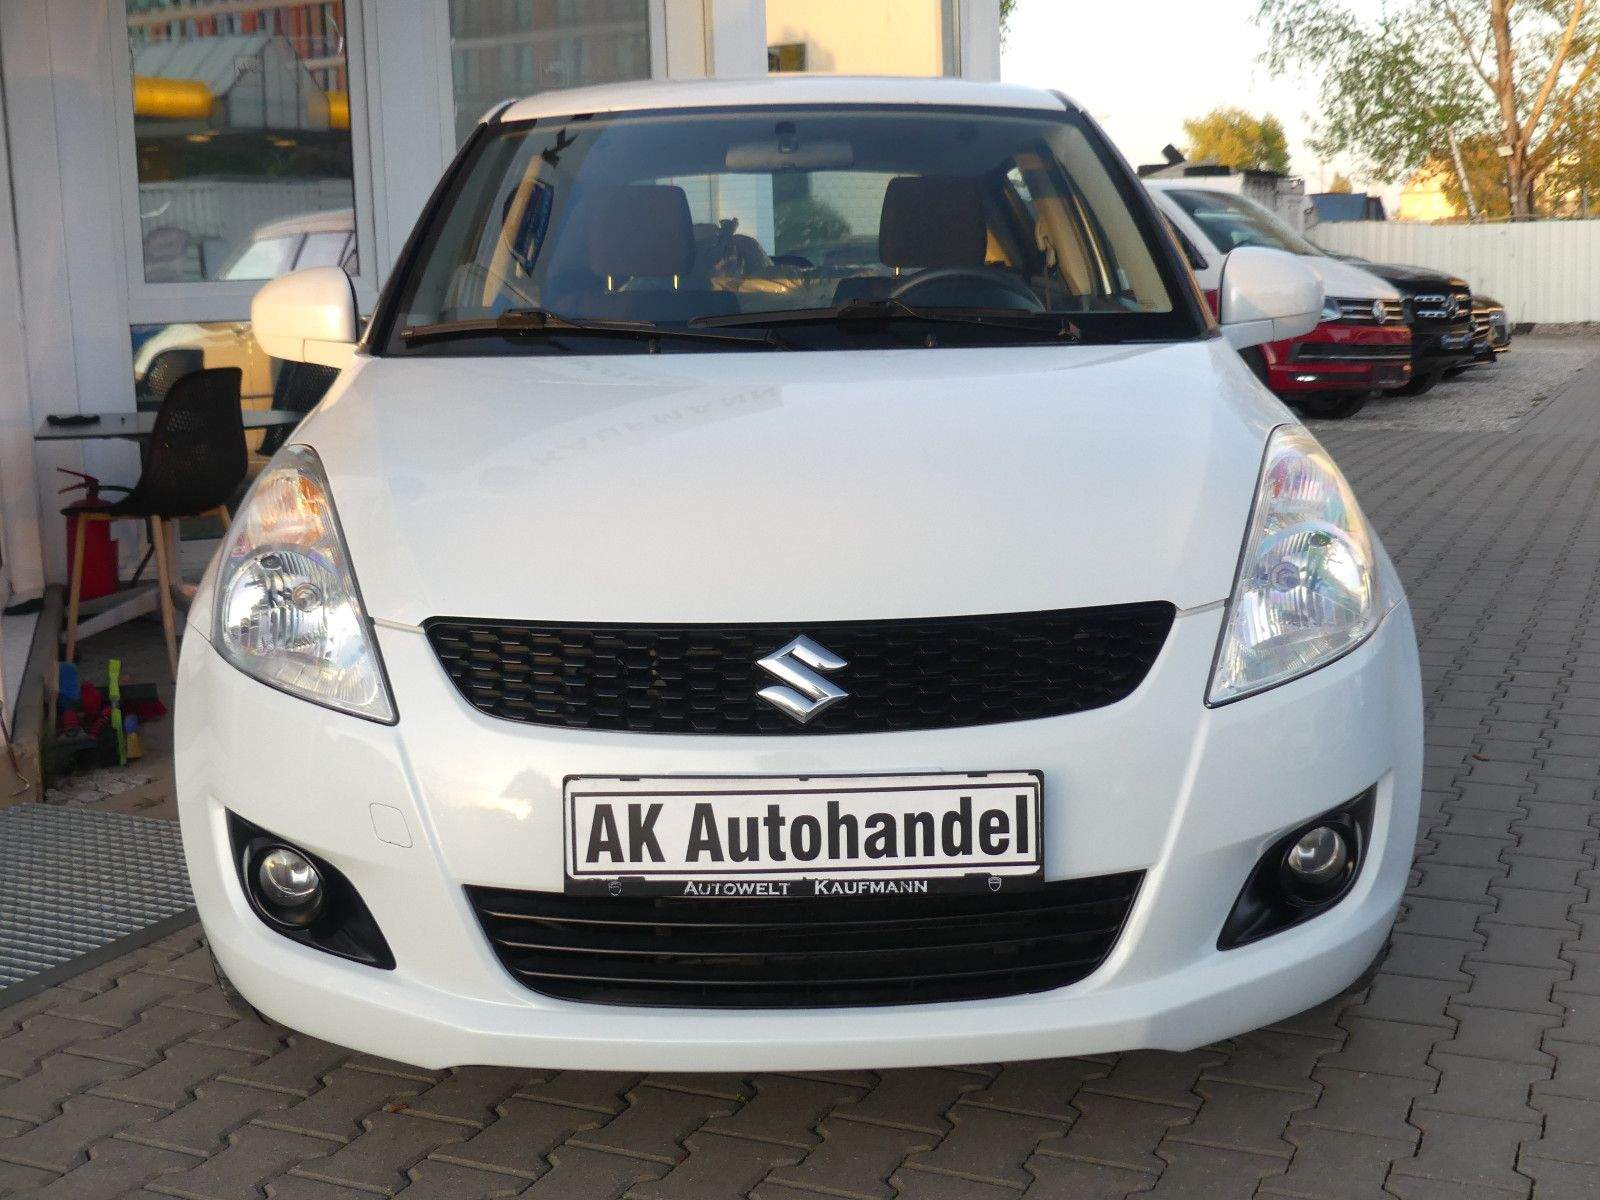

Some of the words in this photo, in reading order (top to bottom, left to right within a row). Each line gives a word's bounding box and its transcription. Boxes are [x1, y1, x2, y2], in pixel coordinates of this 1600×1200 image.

[586, 803, 665, 864] AK
[685, 794, 1030, 863] Autohandel
[683, 880, 791, 896] AUTOWELT
[814, 880, 929, 896] KAUFMANN
